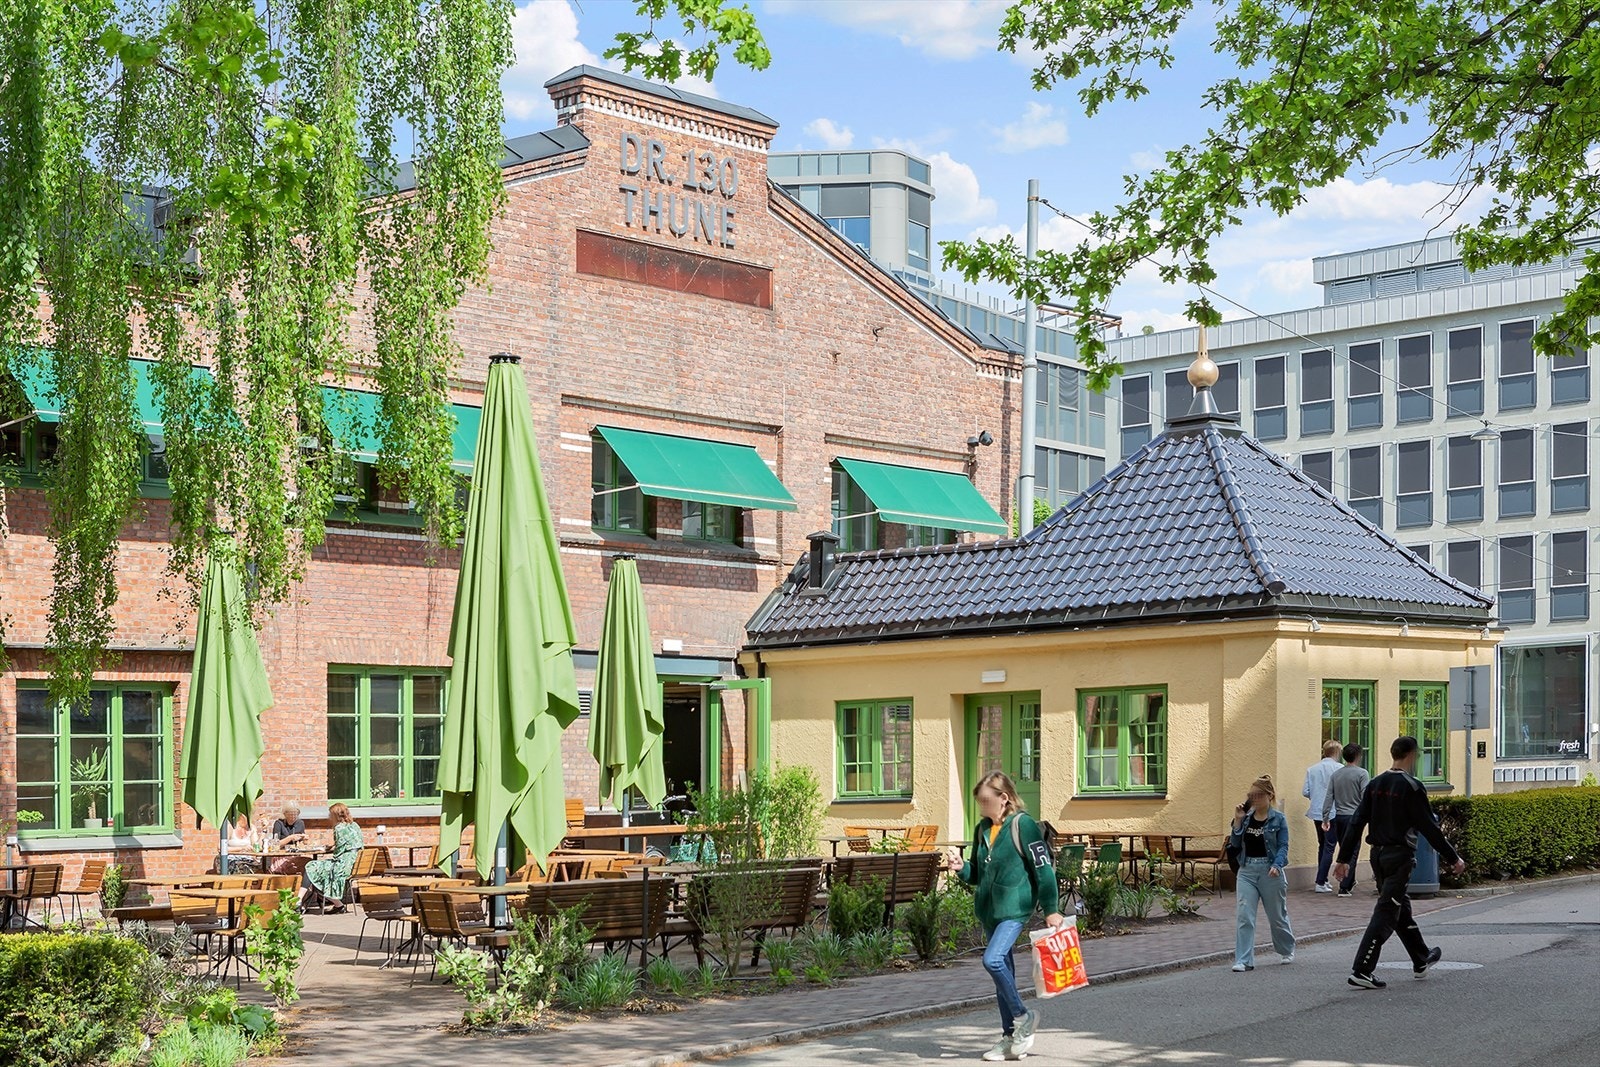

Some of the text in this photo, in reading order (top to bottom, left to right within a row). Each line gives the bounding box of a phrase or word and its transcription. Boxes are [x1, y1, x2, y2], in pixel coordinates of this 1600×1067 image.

[682, 149, 738, 199] 130
[619, 183, 736, 248] THUNE
[1558, 740, 1580, 752] fresh
[1028, 841, 1050, 868] R
